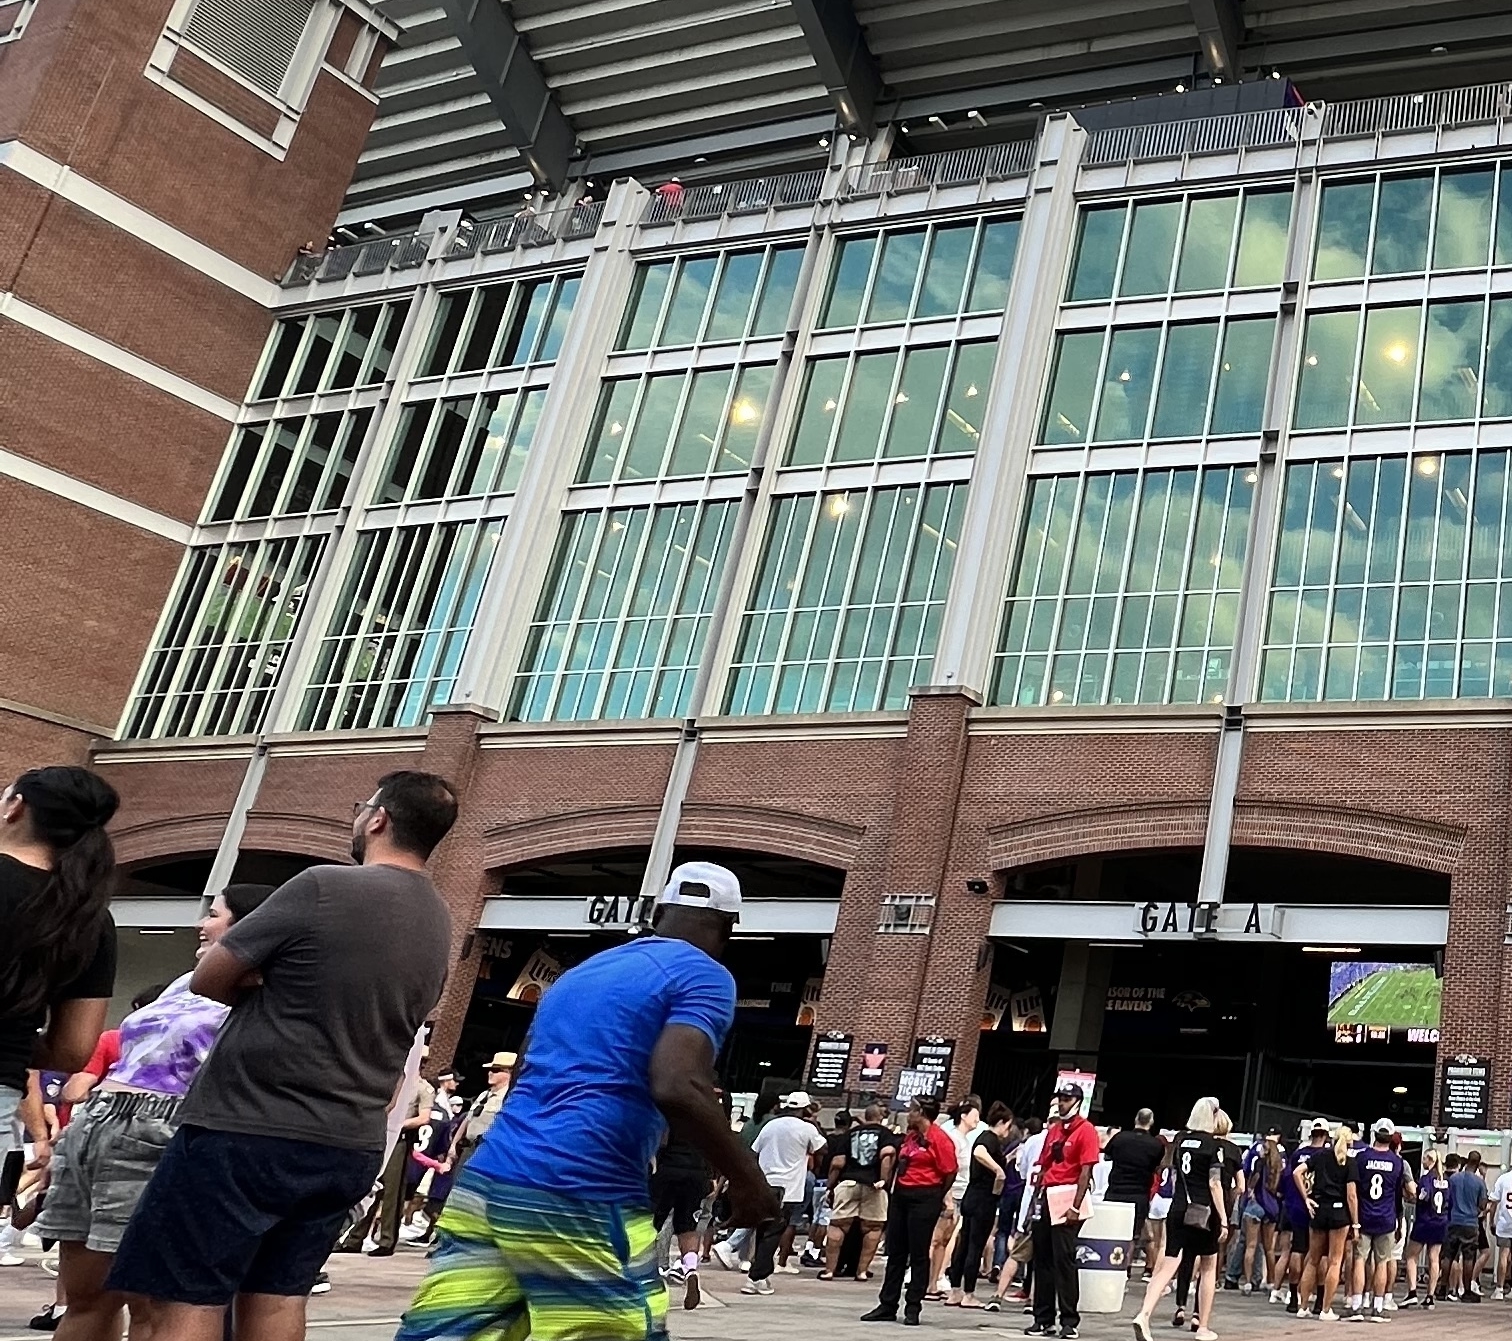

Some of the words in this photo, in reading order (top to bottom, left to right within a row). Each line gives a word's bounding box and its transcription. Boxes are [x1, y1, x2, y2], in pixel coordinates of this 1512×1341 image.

[1141, 901, 1220, 934] GATE
[1244, 901, 1262, 934] A
[1181, 1151, 1192, 1175] 8
[1369, 1173, 1384, 1200] 8
